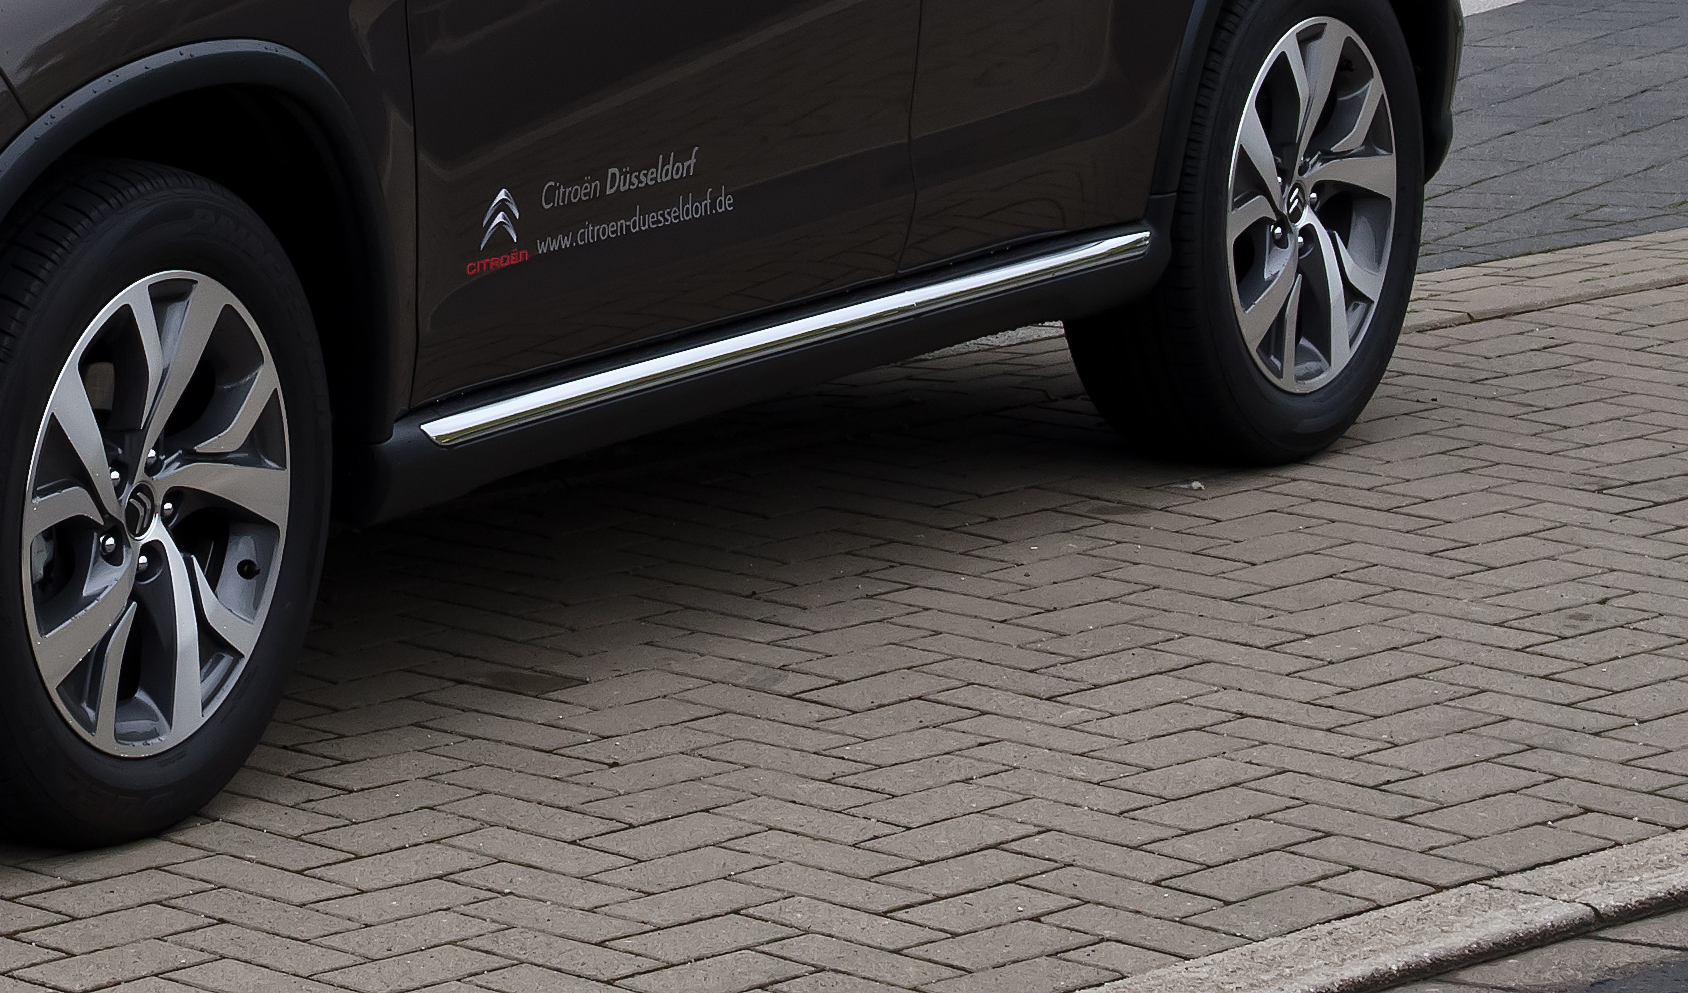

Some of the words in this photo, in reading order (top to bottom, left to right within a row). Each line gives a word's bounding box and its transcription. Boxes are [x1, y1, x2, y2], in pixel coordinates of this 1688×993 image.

[541, 176, 601, 210] Citroën
[605, 146, 699, 196] Düsseldorf
[536, 185, 734, 254] www.citroen-duesseldorf.de
